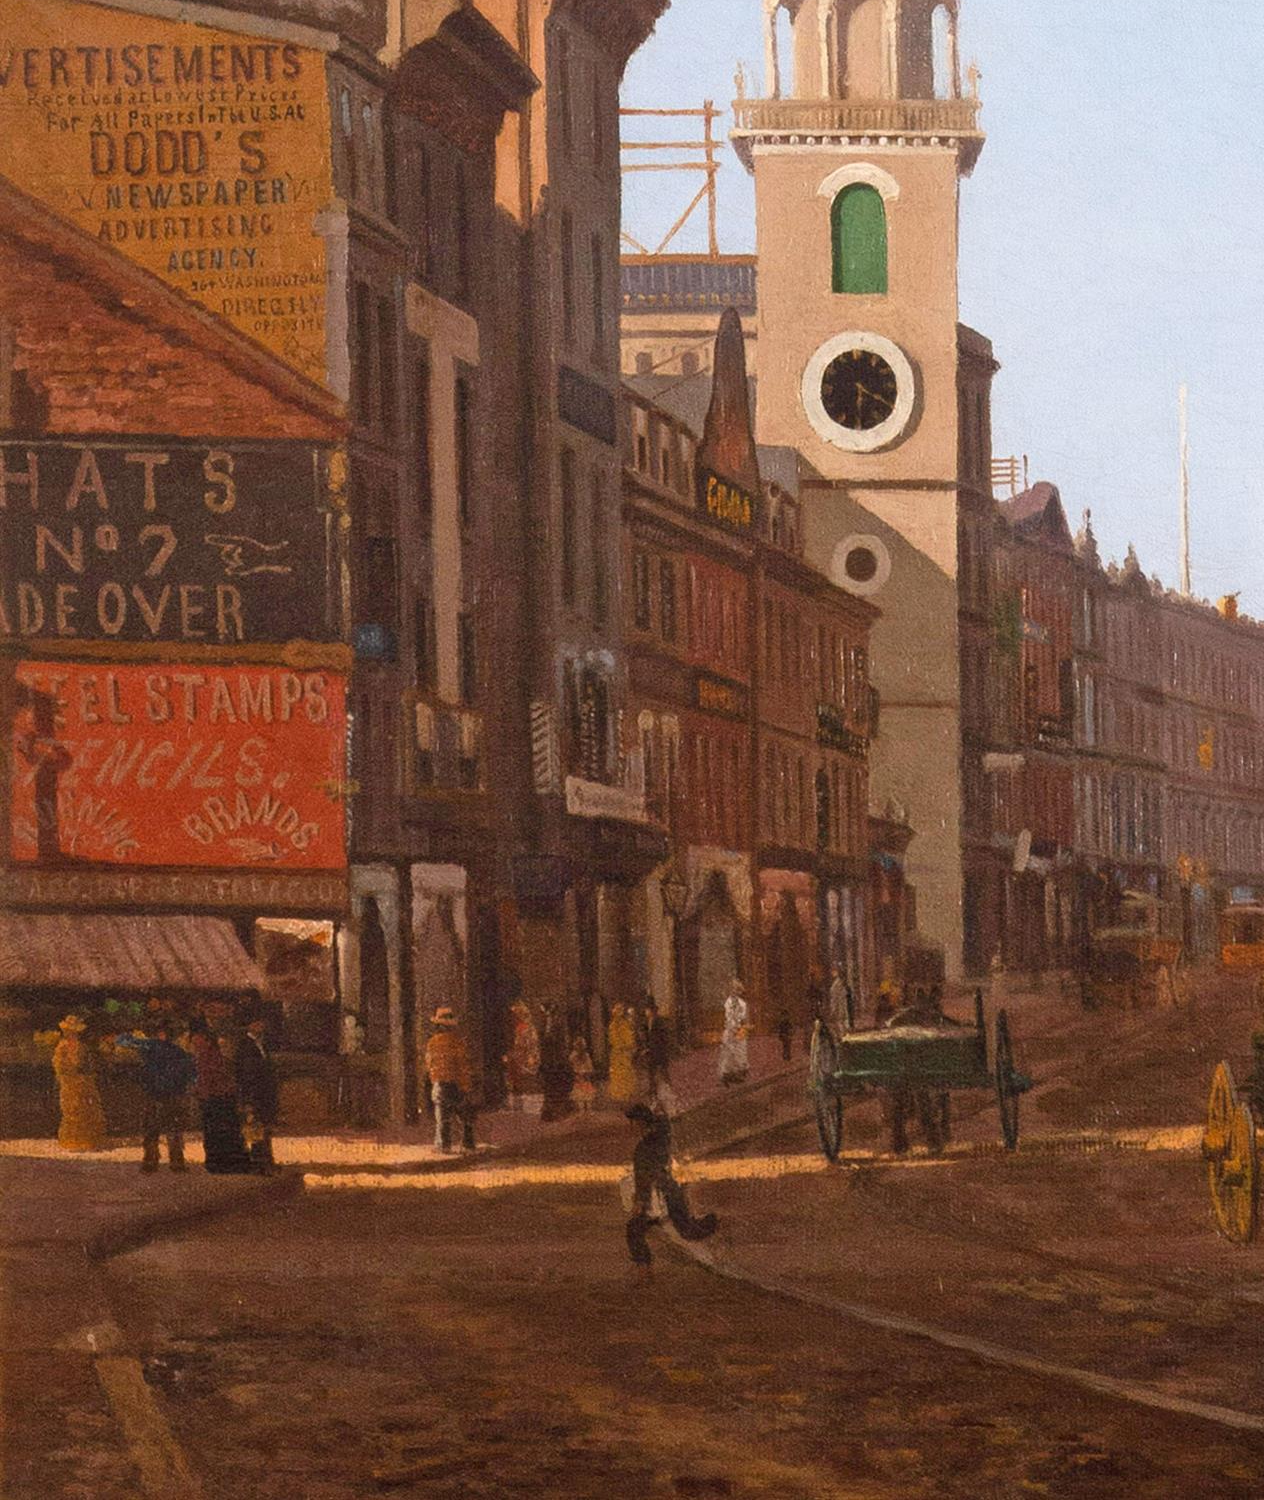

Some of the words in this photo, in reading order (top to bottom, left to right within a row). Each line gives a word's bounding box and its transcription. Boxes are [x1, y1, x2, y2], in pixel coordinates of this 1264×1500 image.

[90, 129, 268, 176] DODD'S
[98, 212, 273, 243] ADVERTISING
[0, 450, 236, 513] HATS
[97, 582, 244, 640] OVER
[146, 671, 329, 724] STAMPS
[182, 790, 320, 850] BRANDS
